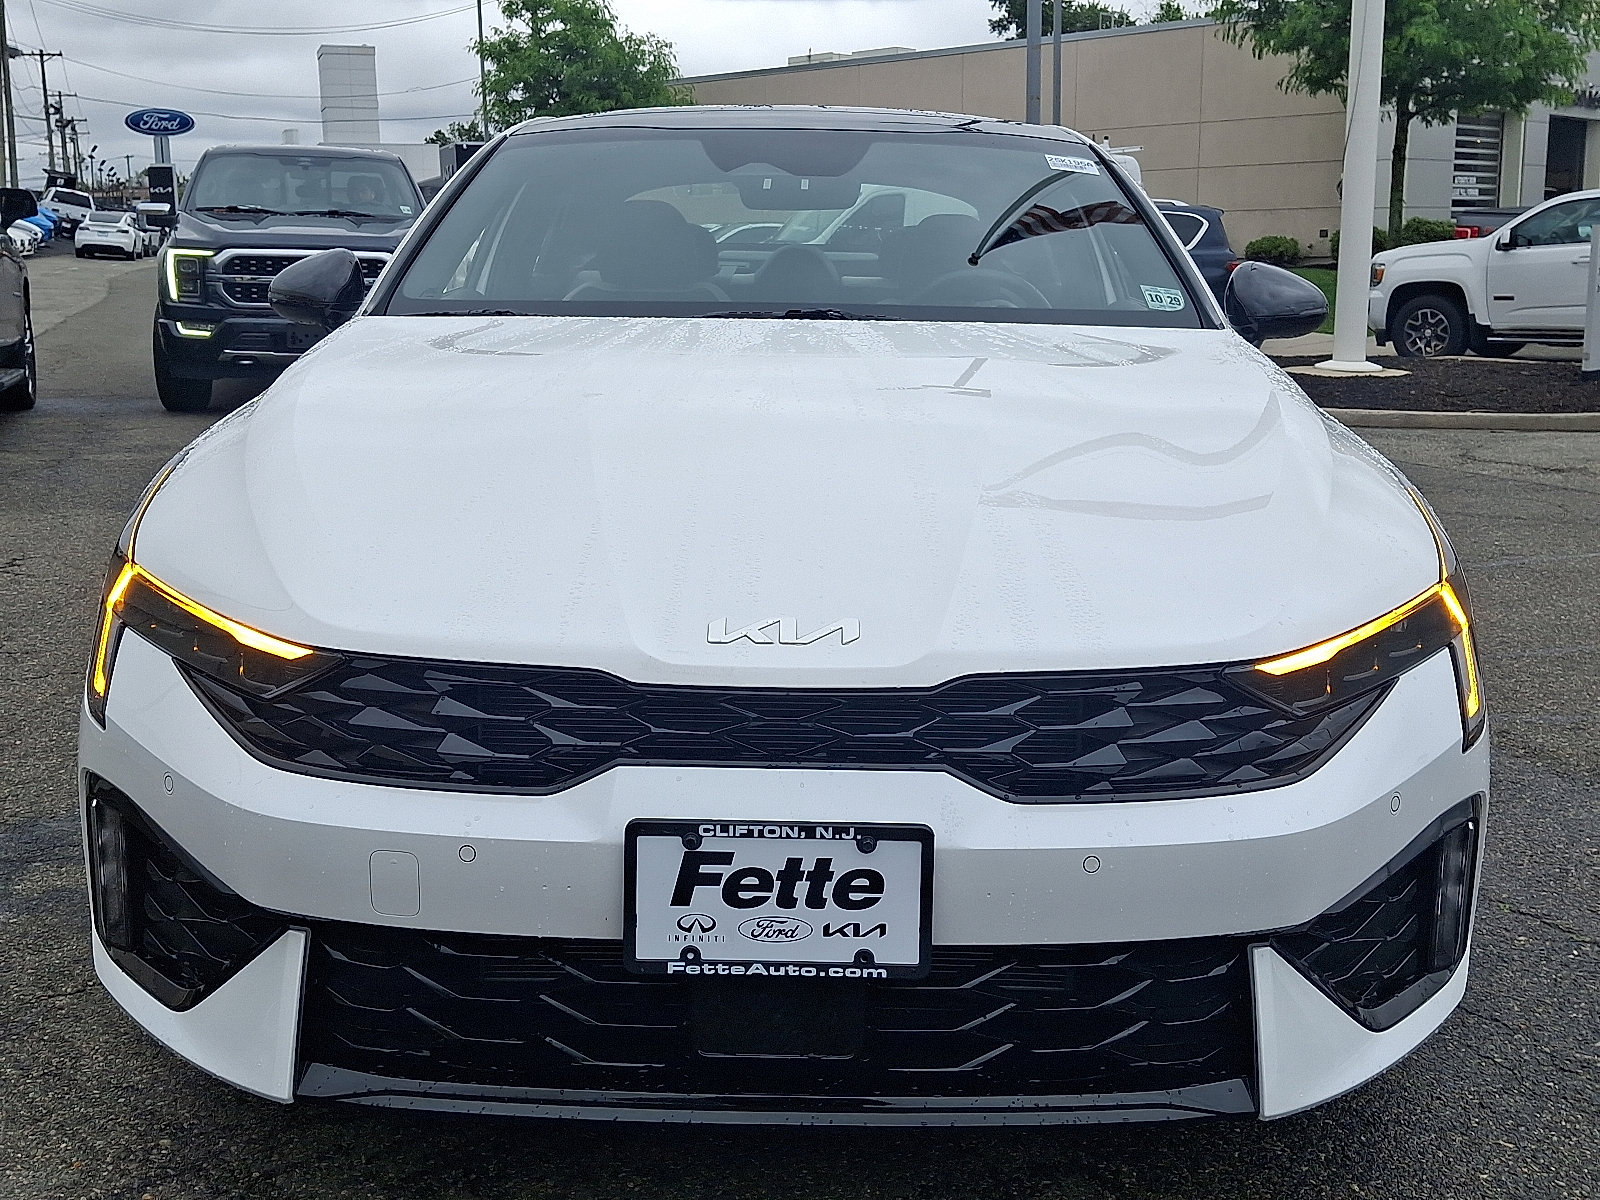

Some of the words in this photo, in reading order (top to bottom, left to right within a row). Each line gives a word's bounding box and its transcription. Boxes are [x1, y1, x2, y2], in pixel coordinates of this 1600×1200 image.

[140, 112, 180, 130] Ford
[1147, 293, 1164, 303] 10
[1166, 296, 1181, 306] 29
[707, 617, 860, 645] KIA
[699, 824, 806, 839] CLIFTON,
[815, 826, 862, 839] N.J.
[670, 850, 885, 910] Fette
[667, 934, 726, 943] INFINITI
[750, 918, 800, 938] Ford
[822, 922, 887, 938] KIA
[667, 961, 888, 978] FetteAuto.com
